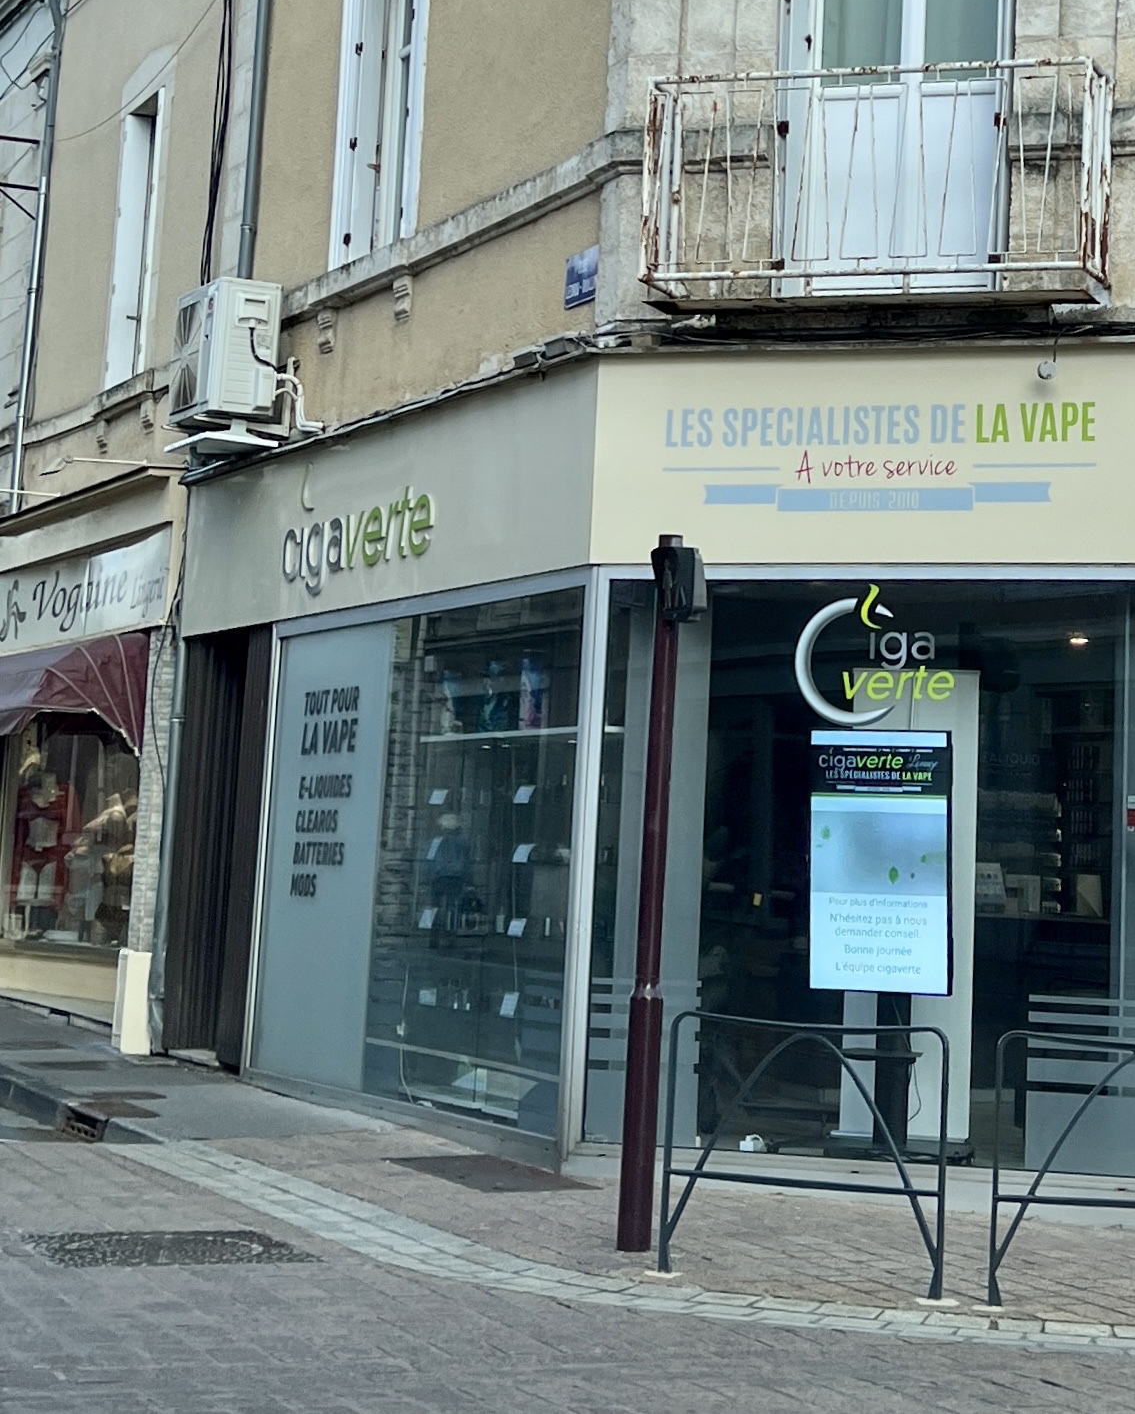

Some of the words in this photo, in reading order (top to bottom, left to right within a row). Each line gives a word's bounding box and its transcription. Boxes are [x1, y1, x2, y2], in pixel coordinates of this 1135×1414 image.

[665, 407, 713, 448] LES
[722, 404, 920, 448] SPECIALISTES
[930, 403, 966, 444] DE
[975, 403, 1010, 444] LA
[1020, 401, 1096, 443] VAPE
[795, 449, 814, 485] A
[822, 454, 878, 478] votre
[883, 453, 958, 479] service
[829, 491, 880, 510] DEPUIS
[283, 462, 435, 597] cigaverte
[842, 665, 955, 701] verte
[304, 689, 331, 717] TOUT
[330, 686, 360, 714] POUR
[301, 721, 319, 756] LA
[322, 717, 359, 754] VAPE
[819, 748, 904, 772] cigaverte
[299, 774, 352, 800] E-LIQUIDES
[902, 772, 911, 780] LA
[295, 809, 339, 833] CLEAROS
[292, 841, 345, 866] BATTERIES
[290, 873, 317, 897] MODS
[829, 896, 848, 906] Pour
[850, 898, 868, 907] plus
[834, 927, 882, 938] demander
[875, 916, 893, 926] pas
[904, 918, 927, 926] nous
[844, 944, 874, 955] Bonne
[876, 945, 912, 957] journée
[835, 962, 875, 974] L'équipe
[877, 964, 921, 975] cigaverte
